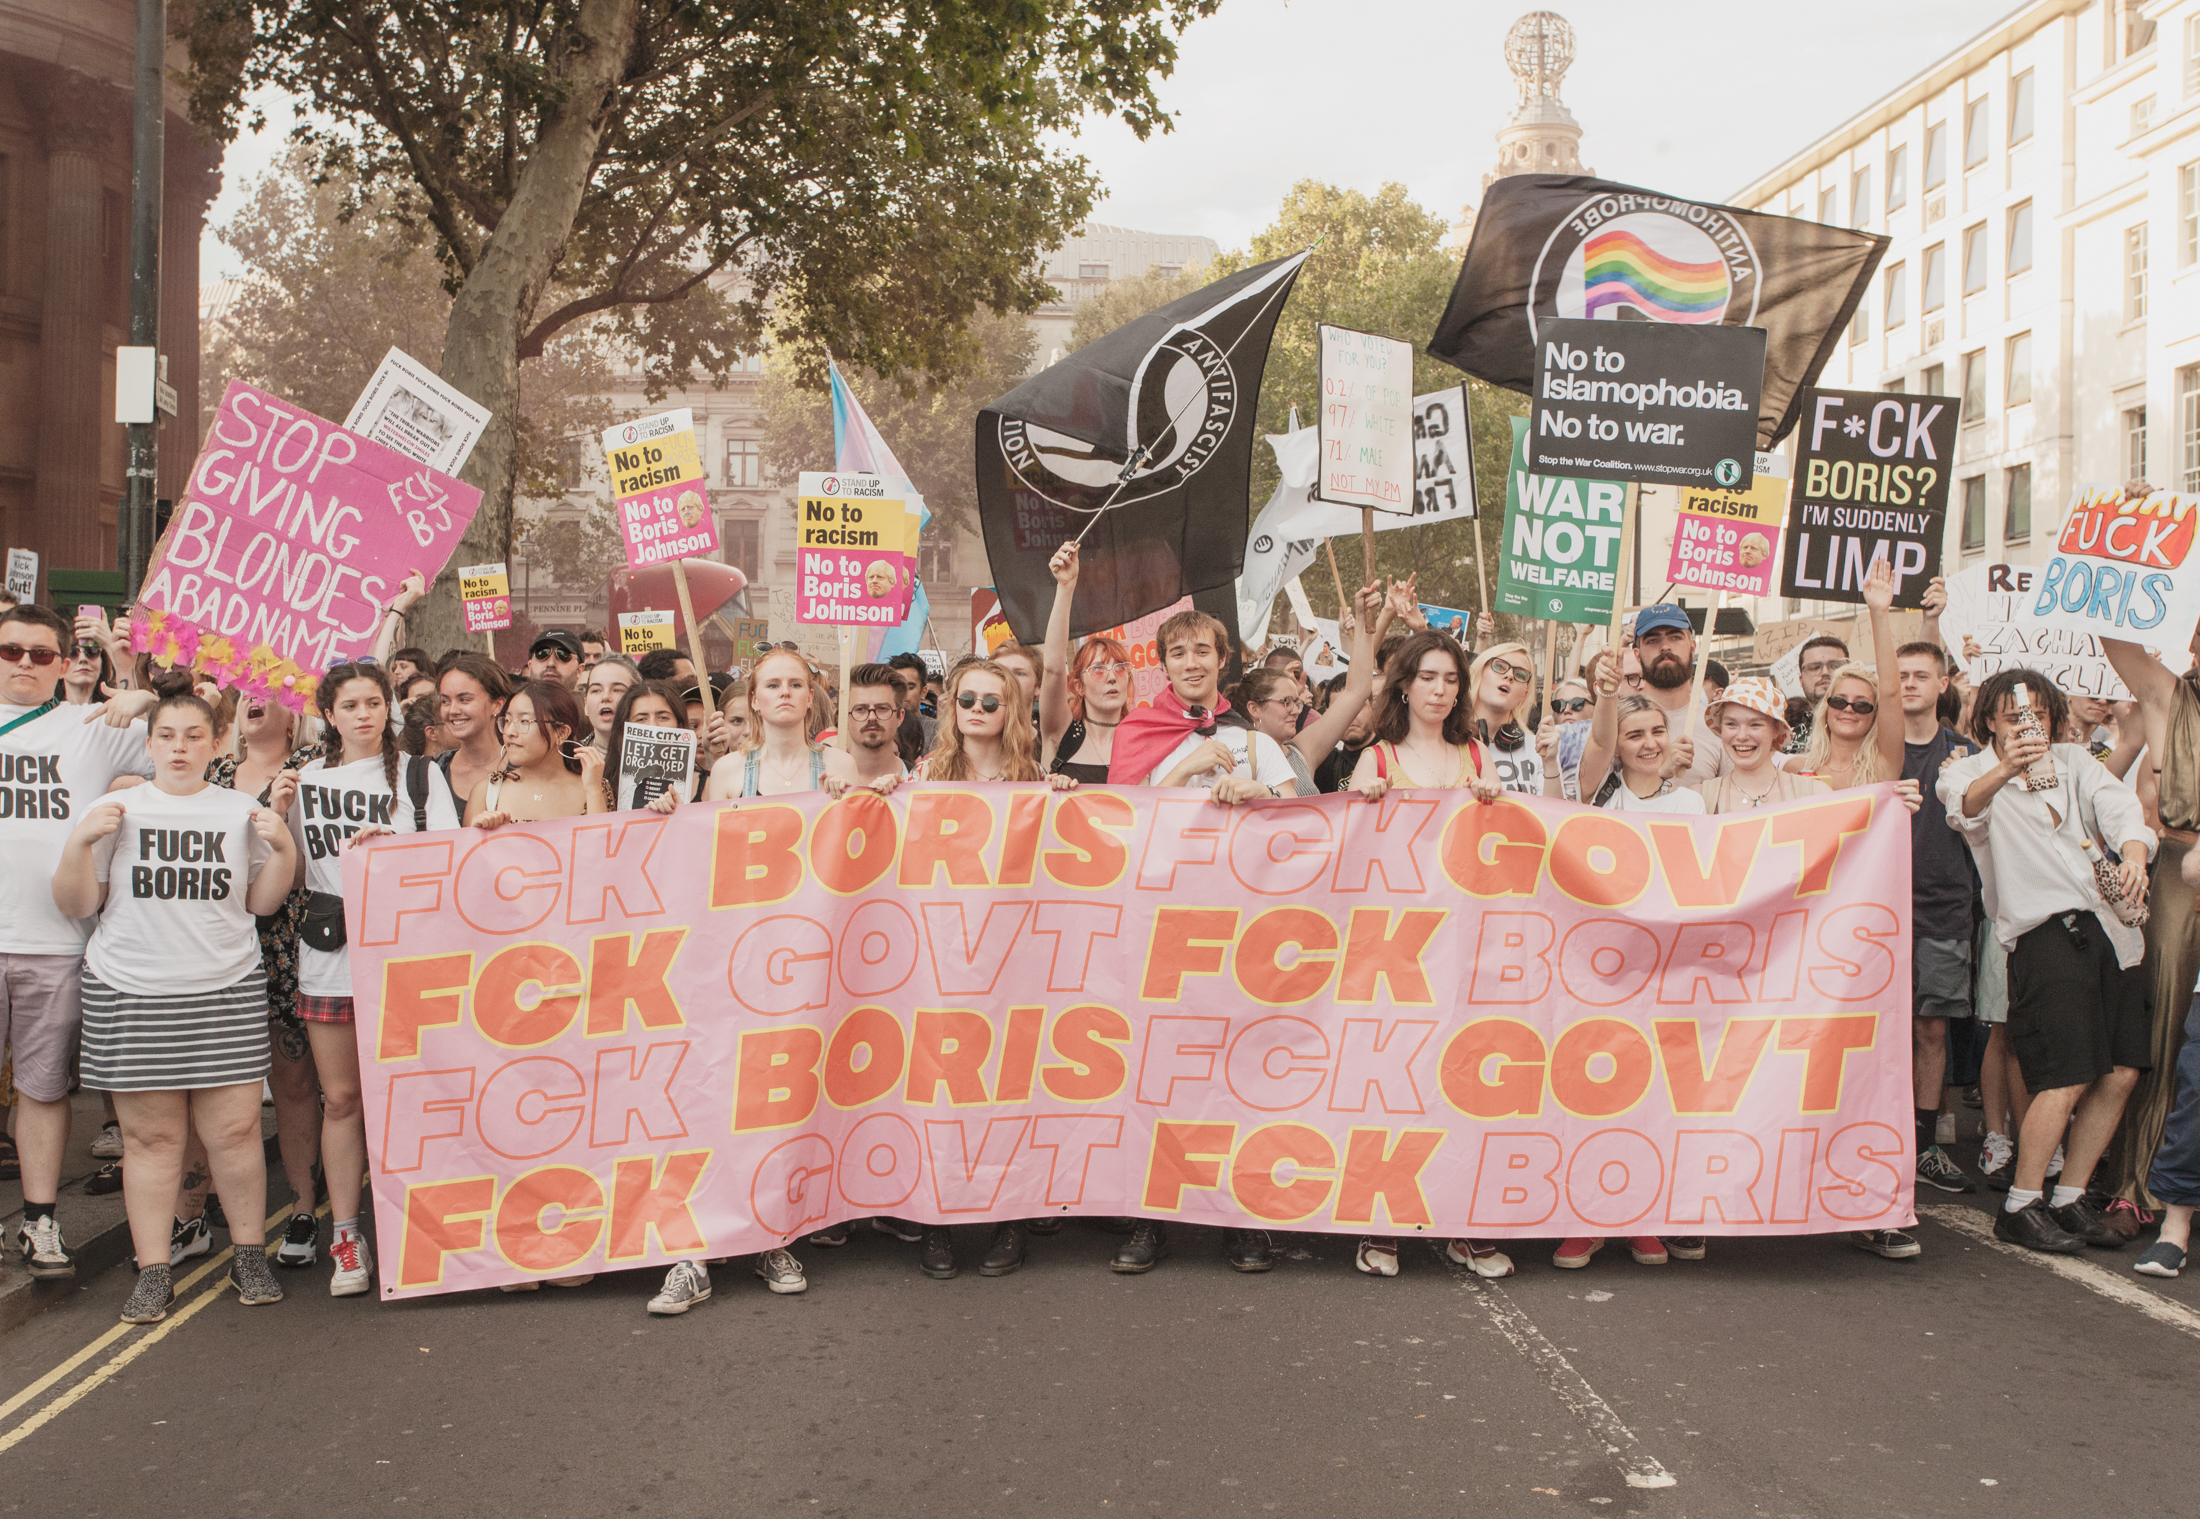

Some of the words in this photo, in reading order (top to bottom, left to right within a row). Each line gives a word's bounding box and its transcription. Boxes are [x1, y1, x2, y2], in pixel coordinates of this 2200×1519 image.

[1327, 327, 1352, 346] WHO
[1361, 334, 1393, 355] VOTED
[1338, 350, 1359, 366] FOR
[1363, 354, 1387, 374] YOU?
[1544, 341, 1588, 371] No
[1593, 346, 1625, 373] to
[362, 400, 370, 412] FUCK
[369, 387, 379, 400] BORIS
[378, 375, 386, 388] FUCK
[390, 359, 401, 369] FUCK
[402, 367, 415, 378] BORIS
[415, 376, 427, 387] FUCK
[427, 384, 439, 396] BORIS
[440, 393, 451, 403] FUCK
[451, 401, 464, 413] BORIS
[464, 410, 475, 420] FUCK
[1365, 384, 1377, 401] OF
[1542, 371, 1749, 412] Islamophobia.
[1175, 338, 1232, 478] ANTIFASCIST
[215, 392, 357, 483] STOP
[384, 415, 395, 426] WILL
[395, 423, 404, 432] ALL
[404, 428, 419, 442] BREAK
[419, 439, 430, 449] OUT
[429, 445, 436, 453] IN
[399, 417, 416, 432] TRIBAL
[416, 427, 440, 447] WARRIORS
[637, 418, 659, 431] STAND
[660, 416, 669, 426] UP
[639, 431, 649, 440] TO
[649, 424, 675, 438] RACISM
[1365, 412, 1396, 437] WHITE
[1539, 409, 1582, 439] No
[1587, 414, 1619, 441] to
[1625, 421, 1684, 446] war.
[383, 424, 415, 447] WATERMELON
[415, 443, 430, 458] SMILES
[385, 434, 394, 442] SEE
[394, 438, 403, 447] THE
[402, 445, 412, 453] BIG
[411, 451, 427, 464] WHITE
[661, 432, 692, 452] FUCK
[614, 451, 640, 473] No
[642, 446, 663, 465] to
[664, 448, 699, 467] BORIS
[1359, 447, 1383, 467] MALE
[1538, 454, 1558, 466] Stop
[1559, 456, 1574, 466] the
[1574, 457, 1592, 468] War
[1592, 458, 1632, 470] Coalition.
[1634, 463, 1713, 477] www.stopwar.org.uk
[1756, 457, 1768, 465] UP
[387, 468, 444, 515] FCK
[619, 465, 681, 494] racism
[842, 478, 867, 487] STAND
[868, 479, 880, 488] UP
[842, 488, 852, 496] TO
[853, 488, 884, 497] RACISM
[1331, 473, 1356, 491] NOT
[1365, 477, 1380, 494] MY
[1384, 480, 1401, 501] PM
[1805, 458, 1938, 506] BORIS?
[197, 449, 363, 559] GIVING
[624, 500, 651, 523] No
[653, 496, 674, 515] to
[1516, 470, 1624, 523] WAR
[1687, 495, 1758, 519] racism
[406, 493, 453, 547] BJ
[806, 500, 835, 522] No
[841, 503, 863, 523] to
[1018, 511, 1066, 529] Boris
[1833, 507, 1930, 535] SUDDENLY
[628, 516, 679, 544] Boris
[805, 524, 878, 546] racism
[1512, 513, 1621, 568] NOT
[1682, 518, 1711, 541] No
[1716, 524, 1737, 545] to
[2061, 511, 2180, 566] FUCK
[634, 532, 712, 565] Johnson
[1678, 539, 1735, 566] Boris
[167, 501, 386, 643] BLONDES
[804, 553, 834, 576] No
[839, 556, 861, 576] to
[1510, 560, 1615, 591] WELFARE
[1673, 560, 1763, 592] Johnson
[1794, 531, 1927, 597] LIMP
[9, 578, 31, 595] Out!
[463, 579, 477, 588] No
[479, 578, 489, 587] to
[465, 587, 498, 598] racism
[804, 576, 861, 599] Boris
[2033, 557, 2174, 630] BORIS
[466, 601, 480, 612] No
[482, 601, 493, 609] to
[467, 610, 494, 621] Boris
[533, 605, 572, 613] PENNINE
[803, 598, 894, 623] Johnson
[469, 618, 509, 631] Johnson
[624, 628, 640, 640] No
[642, 628, 654, 639] to
[626, 640, 663, 653] racism
[626, 726, 655, 739] REBEL
[656, 731, 682, 741] CITY
[626, 741, 656, 758] LET'S
[660, 746, 687, 761] GET
[0, 753, 63, 784] UCK
[0, 787, 70, 820] ORIS
[301, 784, 393, 825] FUCK
[139, 828, 227, 863] FUCK
[359, 818, 670, 947] FCK
[708, 789, 1138, 911] BORIS
[1135, 798, 1441, 896] FCK
[1437, 794, 1875, 910] GOVT
[131, 865, 232, 900] BORIS
[375, 924, 691, 1063] FCK
[728, 898, 1123, 1017] GOVT
[1138, 904, 1451, 1007] FCK
[1467, 902, 1899, 1007] BORIS
[381, 1040, 692, 1175] FCK
[730, 1003, 1133, 1135] BORIS
[1135, 1014, 1440, 1114] FCK
[1436, 1012, 1880, 1120] GOVT
[398, 1147, 714, 1290] FCK
[750, 1112, 1125, 1237] GOVT
[1140, 1119, 1449, 1229] FCK
[1467, 1121, 1905, 1228] BORIS
